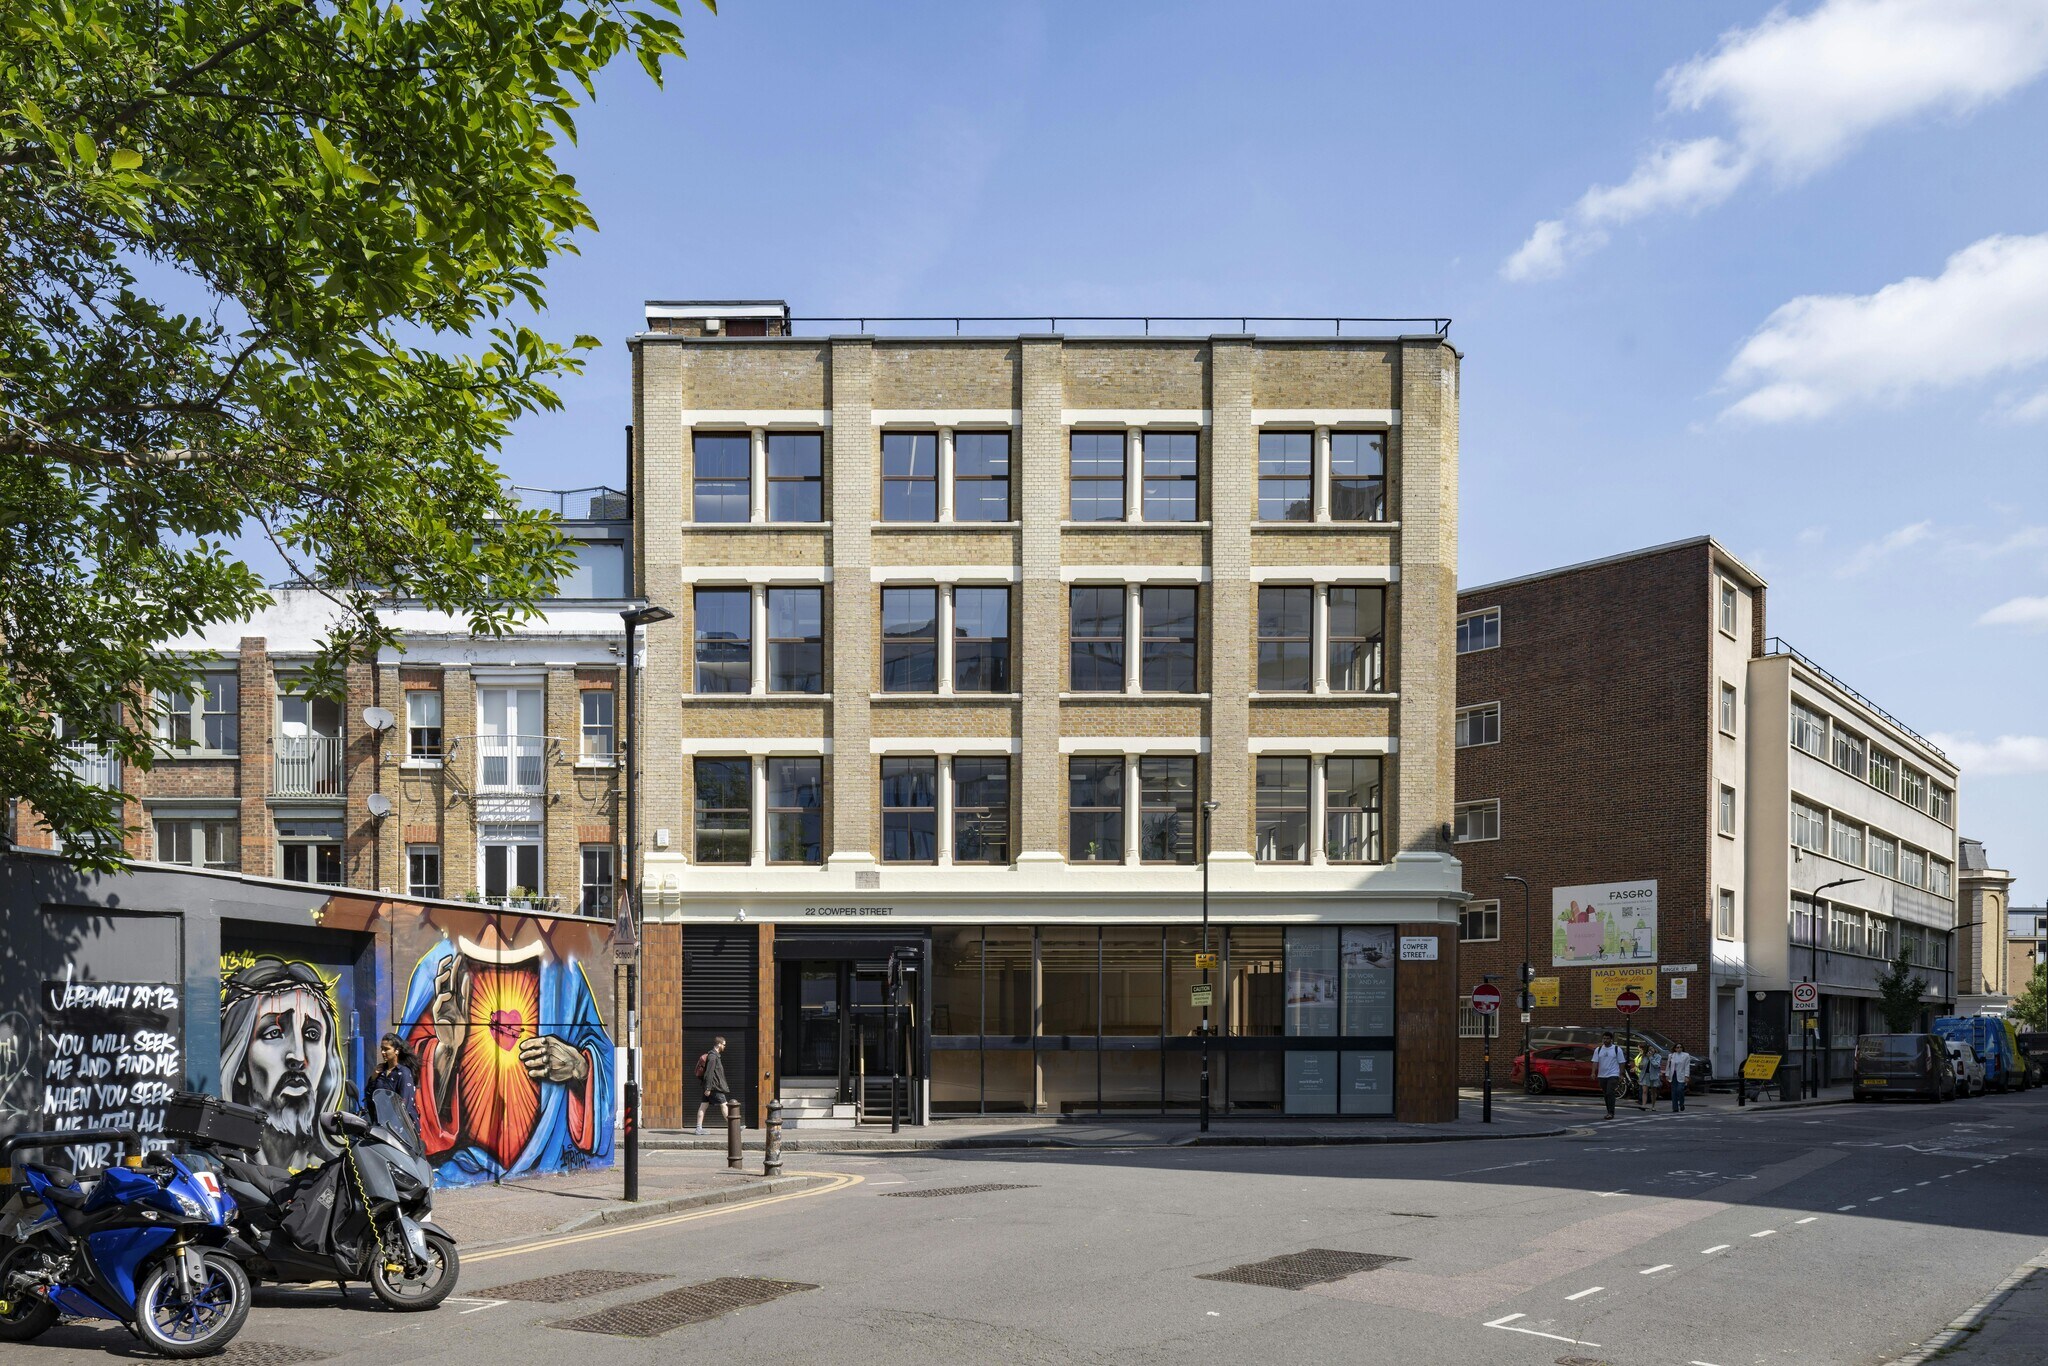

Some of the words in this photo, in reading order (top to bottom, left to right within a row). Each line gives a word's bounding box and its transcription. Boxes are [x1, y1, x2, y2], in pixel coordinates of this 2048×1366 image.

[1609, 889, 1653, 900] FASGRO
[805, 907, 816, 916] 22
[818, 907, 857, 916] COWPER
[859, 907, 893, 916] STREET
[615, 949, 632, 959] School
[1619, 968, 1653, 976] WORLD
[1797, 989, 1812, 997] 20
[48, 1033, 84, 1058] YOU
[92, 1034, 130, 1054] WILL
[133, 1030, 176, 1053] SEEK
[46, 1057, 73, 1080] ME
[77, 1054, 111, 1079] AND
[115, 1053, 155, 1076] FIND
[155, 1050, 180, 1077] ME
[43, 1084, 91, 1114] WHEN
[94, 1084, 128, 1110] YOU
[129, 1081, 174, 1105] SEEK
[137, 1108, 165, 1132] ALL
[64, 1142, 110, 1176] YOUR
[203, 1176, 221, 1193] L
